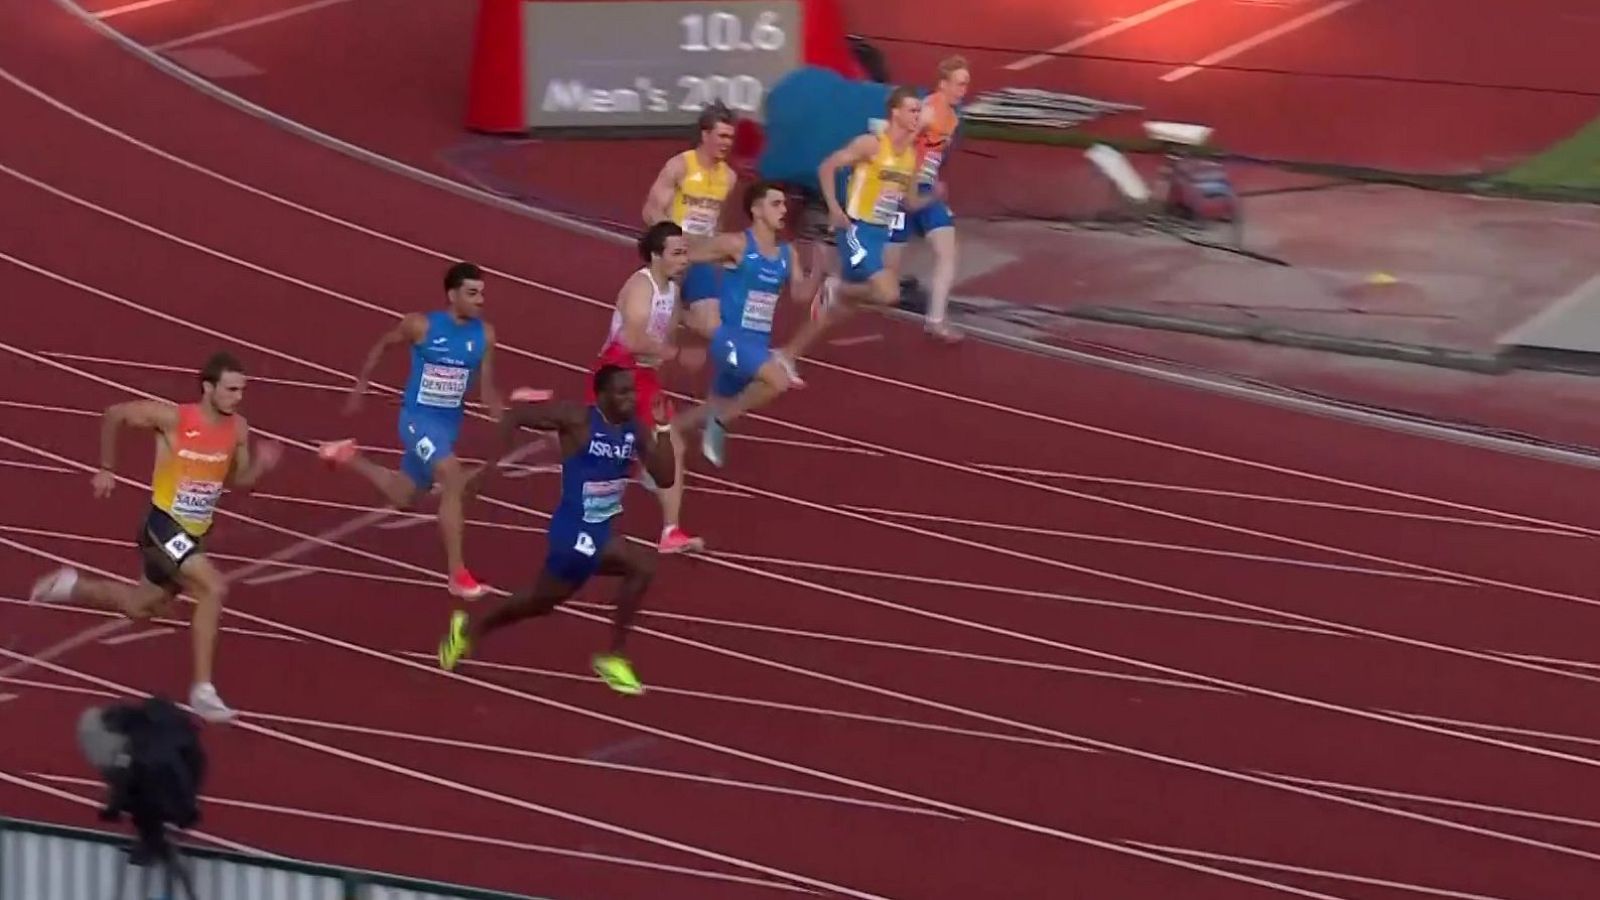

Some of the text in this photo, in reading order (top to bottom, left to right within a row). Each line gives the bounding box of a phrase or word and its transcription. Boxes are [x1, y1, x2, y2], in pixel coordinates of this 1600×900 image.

[678, 11, 786, 52] 10.6
[540, 74, 763, 113] Men's 200
